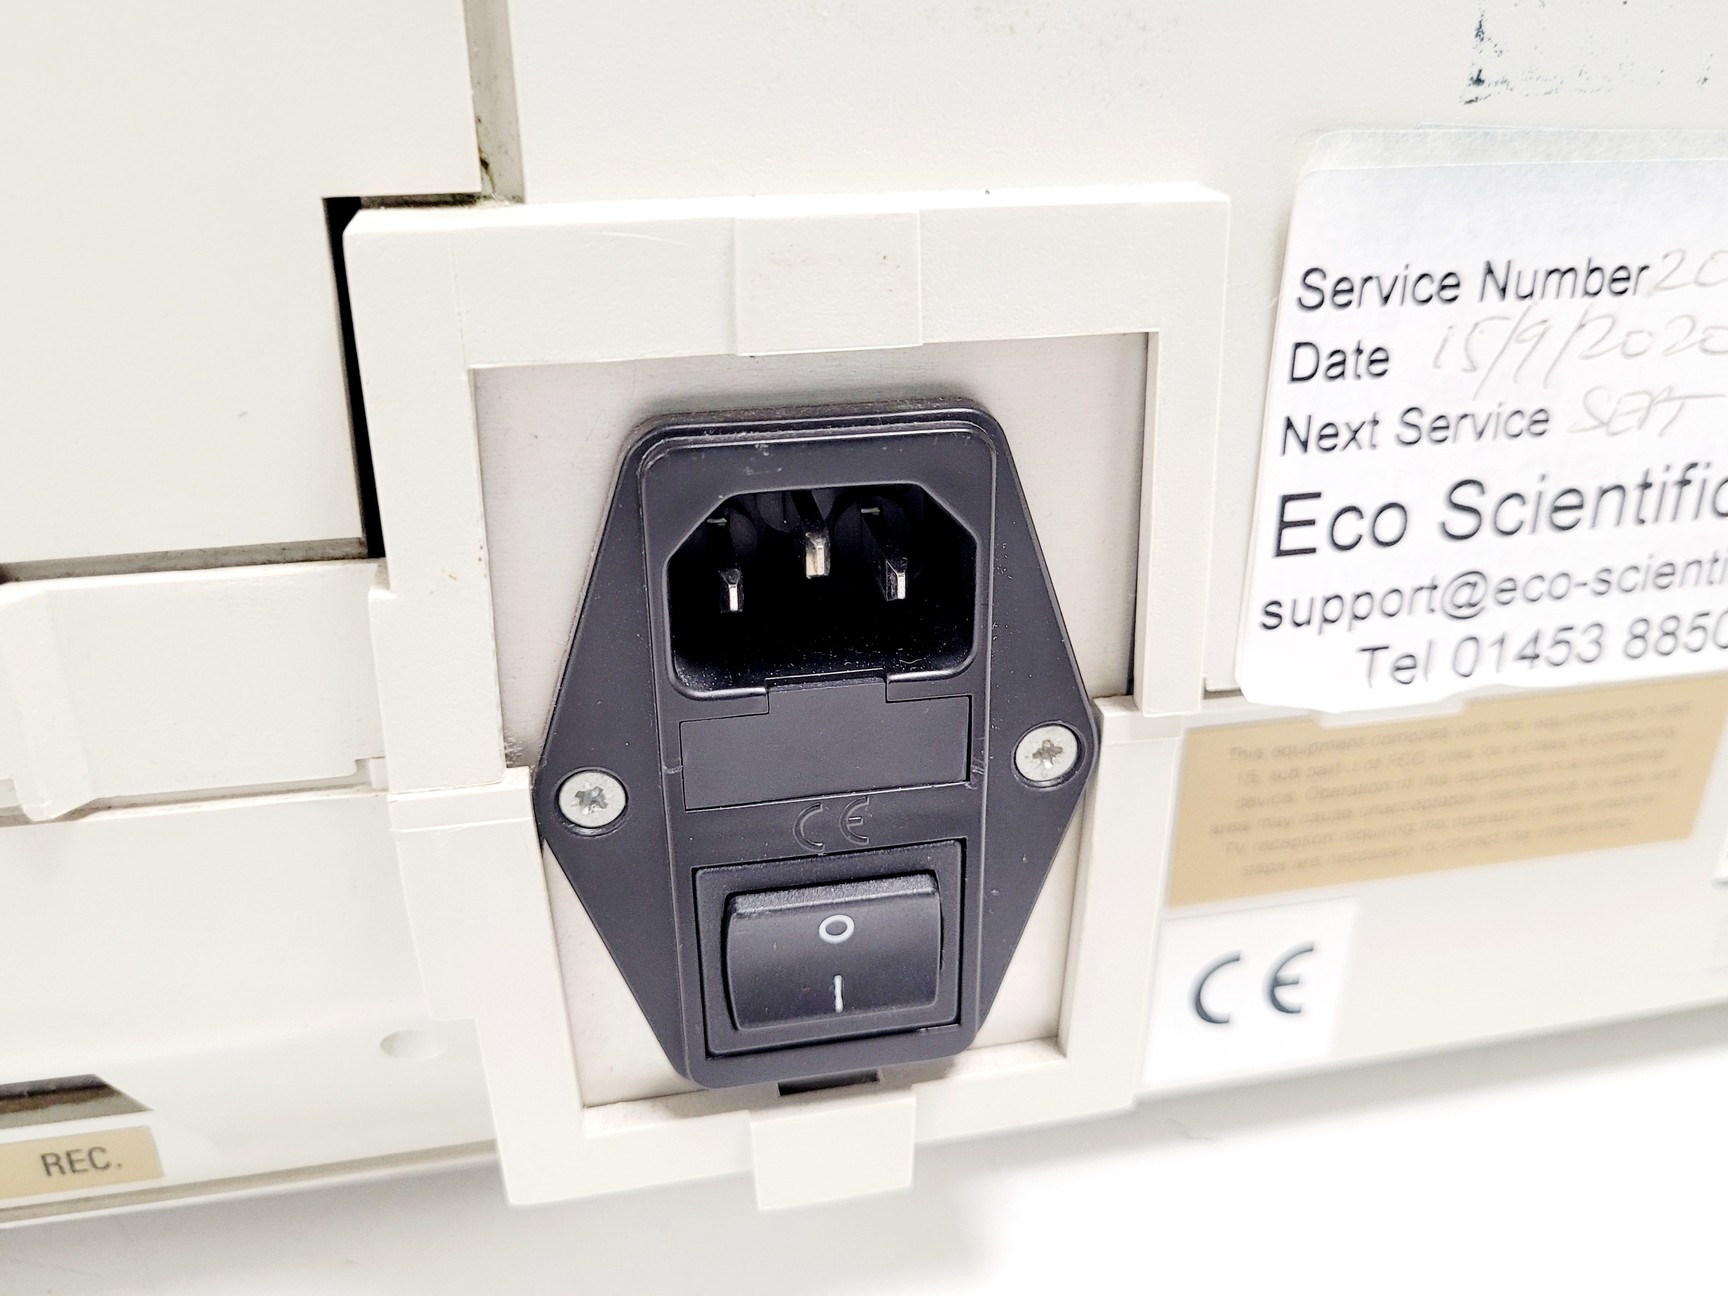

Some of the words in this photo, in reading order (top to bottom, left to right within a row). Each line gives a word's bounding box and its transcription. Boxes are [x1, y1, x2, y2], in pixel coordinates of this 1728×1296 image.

[1297, 264, 1461, 312] Service
[1478, 258, 1650, 302] Number
[1288, 339, 1390, 383] Date
[1280, 411, 1380, 456] Next
[1395, 403, 1550, 448] Service
[1273, 491, 1409, 558] Eco
[1357, 638, 1435, 687] Tel
[1452, 622, 1605, 678] 01453
[39, 1146, 123, 1177] REC.
